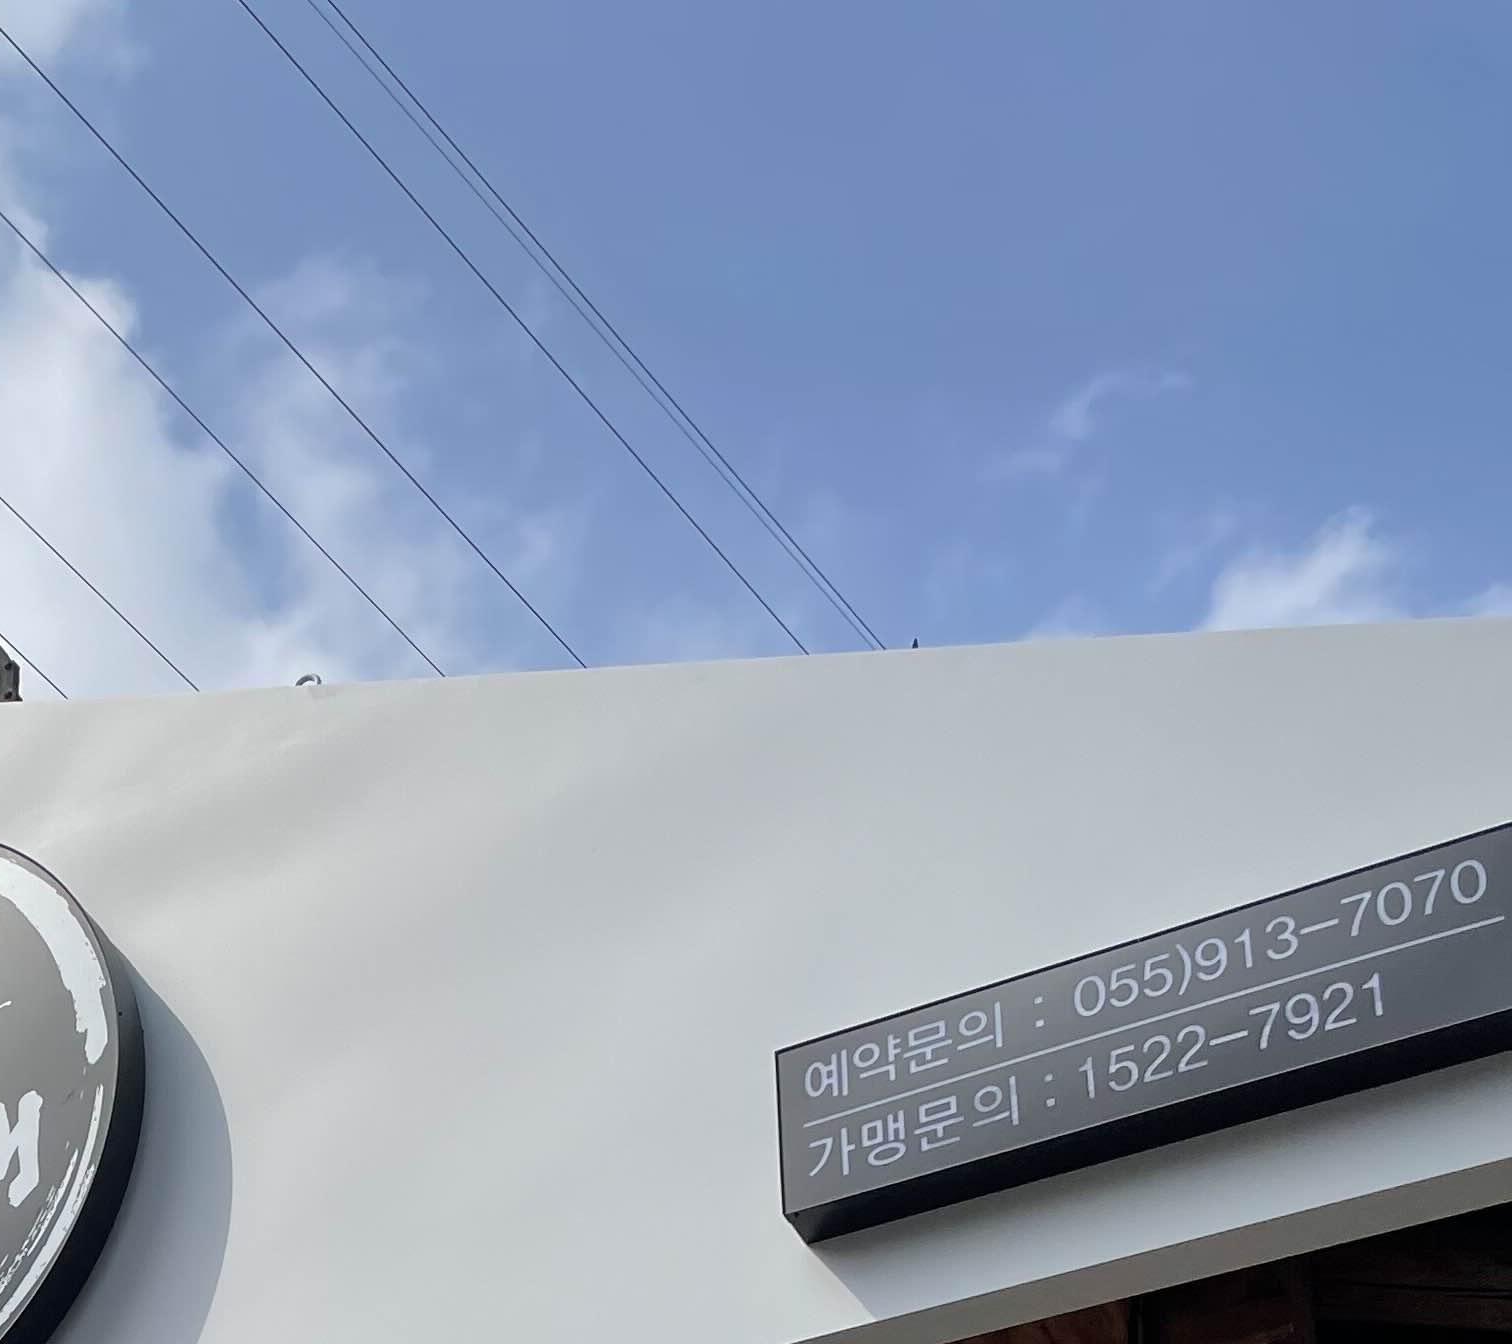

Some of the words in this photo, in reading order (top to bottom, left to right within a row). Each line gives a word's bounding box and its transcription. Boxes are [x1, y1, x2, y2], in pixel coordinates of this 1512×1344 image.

[803, 1001, 1005, 1099] 예약문의
[1073, 857, 1489, 1019] 055)913-7070
[809, 1074, 1020, 1178] 가맹문의
[1081, 972, 1386, 1101] 1522-7921
